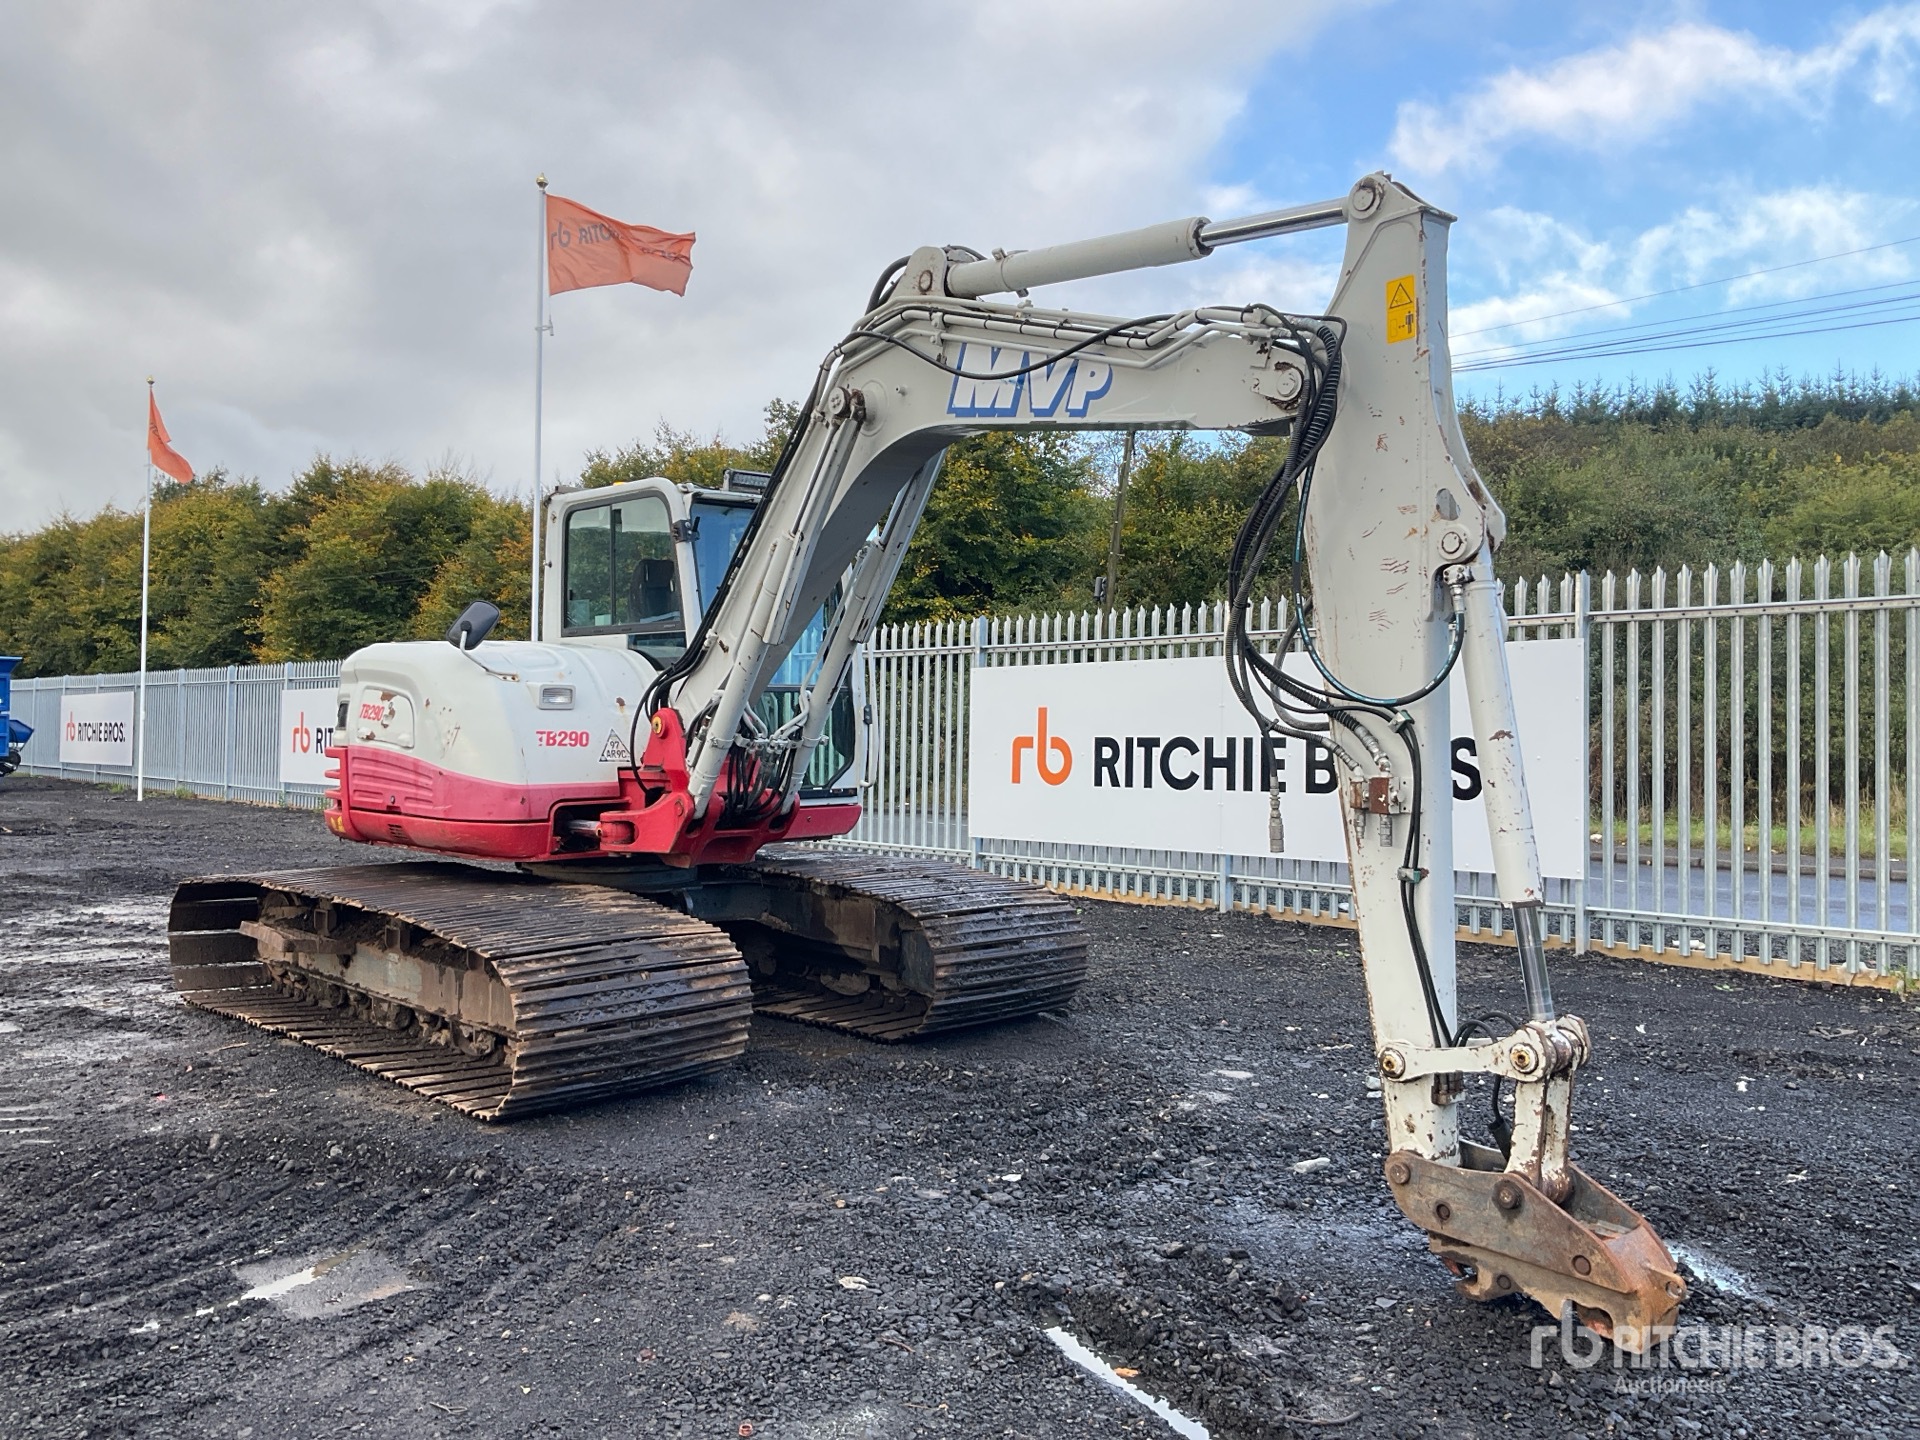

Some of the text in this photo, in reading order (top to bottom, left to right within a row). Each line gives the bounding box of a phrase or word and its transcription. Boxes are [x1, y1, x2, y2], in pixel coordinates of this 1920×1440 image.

[947, 342, 1113, 418] MVP
[360, 704, 385, 721] TB290
[78, 722, 103, 742] RITCHIE
[103, 722, 126, 743] BROS.
[536, 731, 590, 747] TB290
[610, 741, 620, 749] 97
[1011, 707, 1483, 801] rb RITCHIE BS
